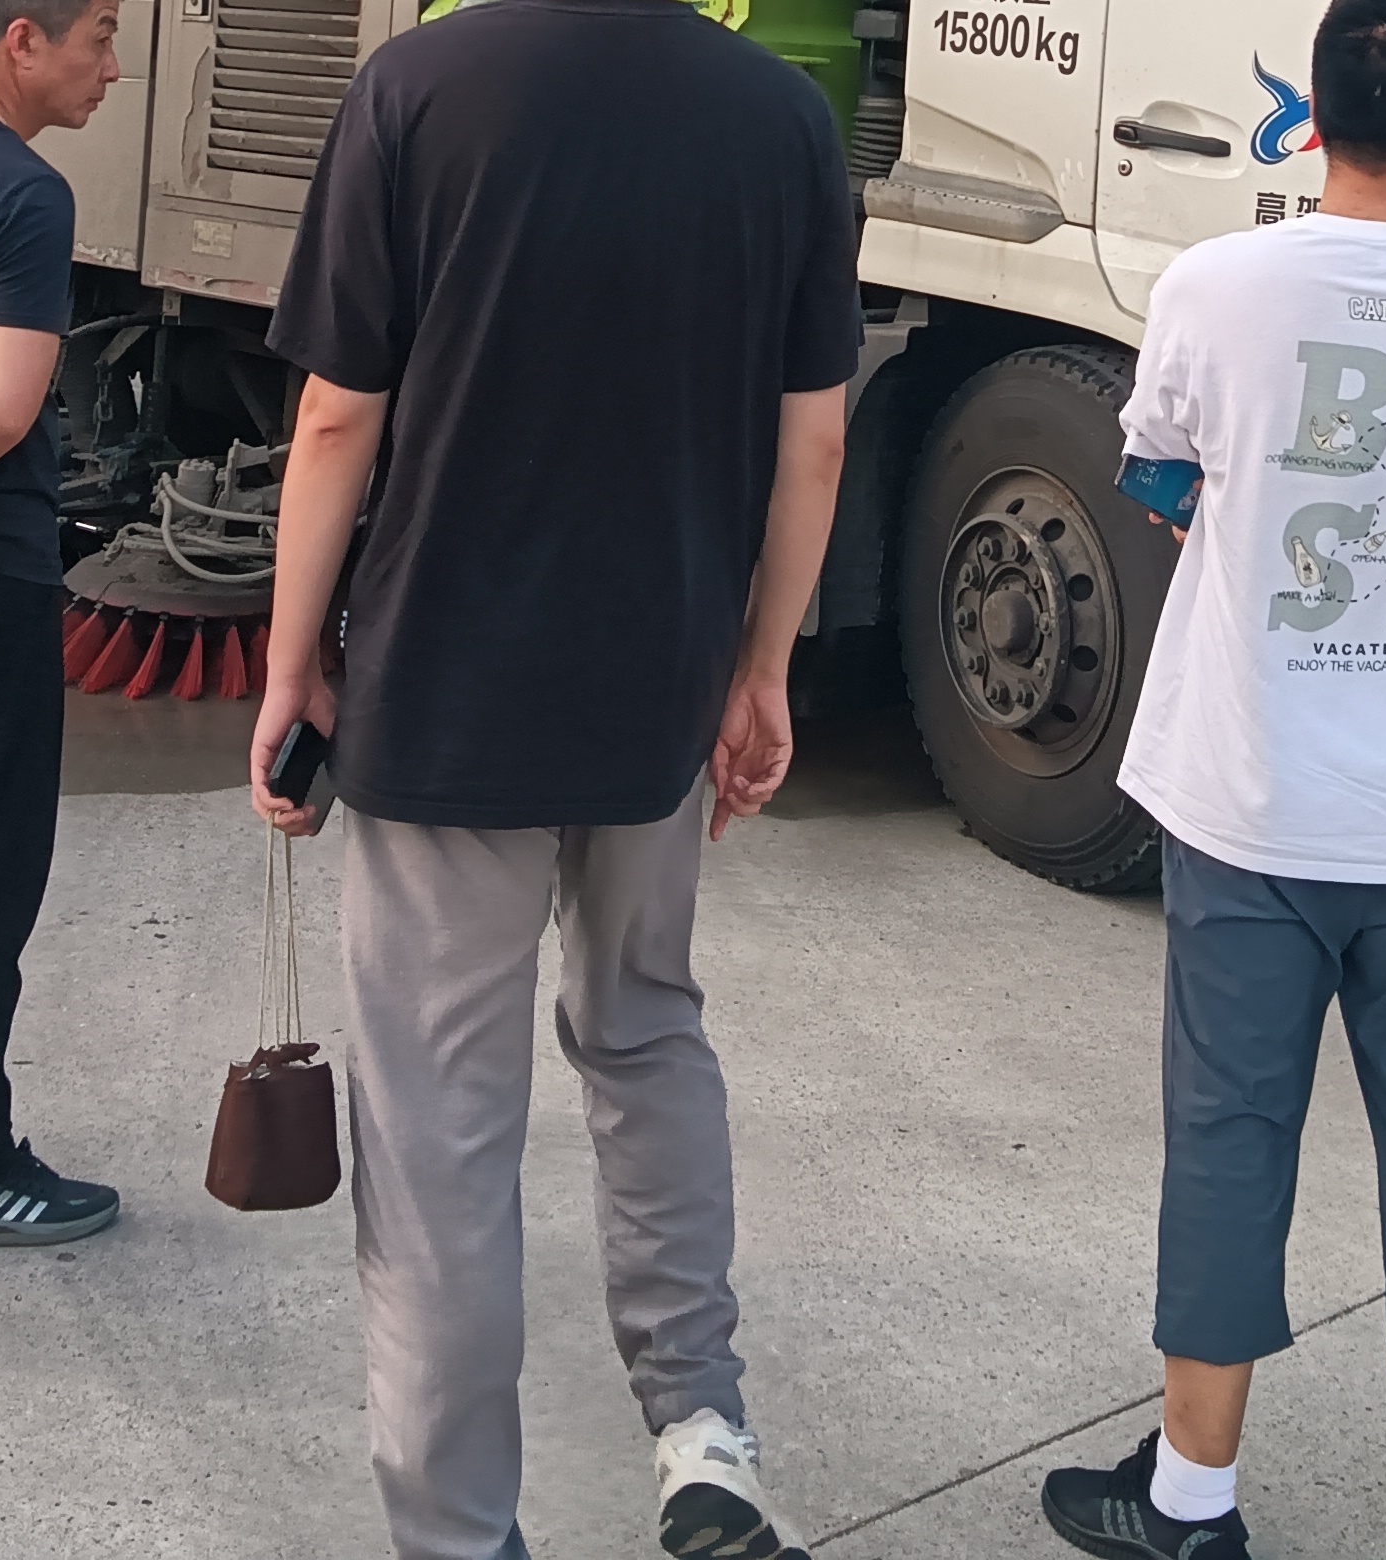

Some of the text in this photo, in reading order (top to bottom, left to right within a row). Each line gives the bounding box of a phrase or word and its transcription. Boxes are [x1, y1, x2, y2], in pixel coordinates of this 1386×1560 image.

[1337, 460, 1377, 473] VOYAGE
[1277, 590, 1302, 602] MAKE
[1304, 593, 1312, 602] A
[1287, 659, 1327, 671] ENJOY
[1330, 659, 1354, 672] THE
